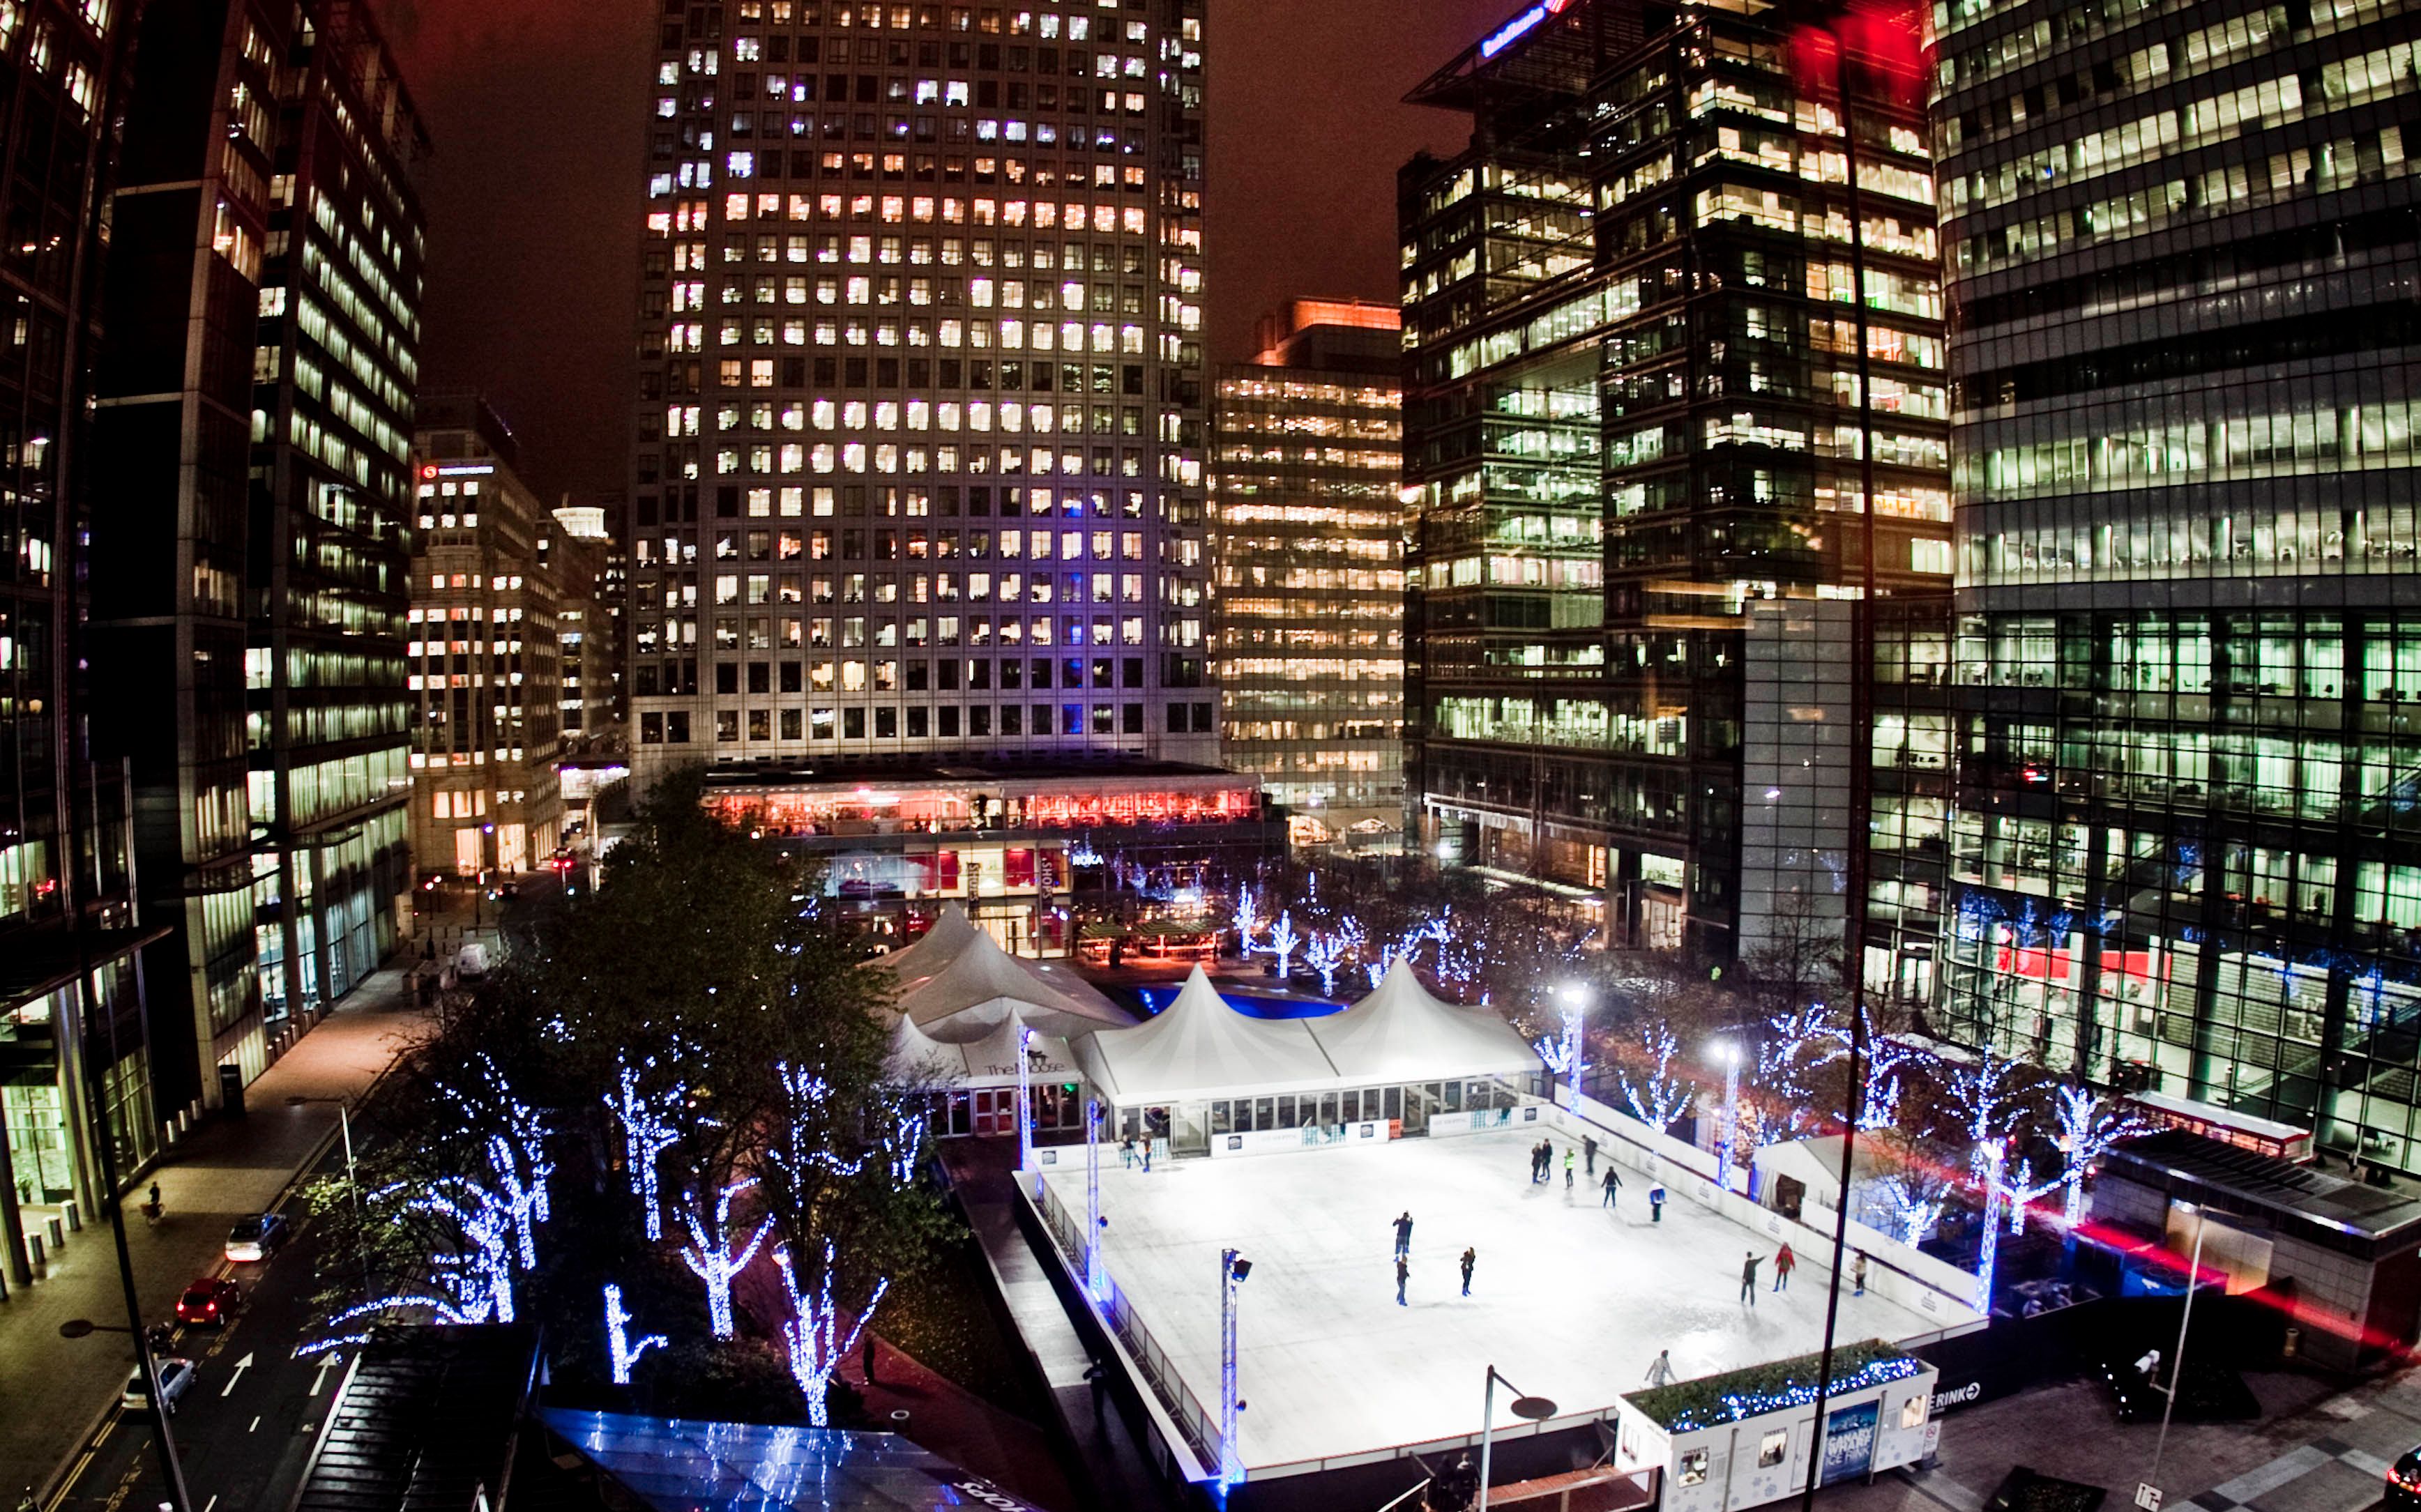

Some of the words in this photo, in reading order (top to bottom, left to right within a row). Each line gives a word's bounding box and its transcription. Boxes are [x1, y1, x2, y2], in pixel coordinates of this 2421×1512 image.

[1072, 855, 1105, 866] ROKA
[1042, 861, 1053, 899] SHOPS
[985, 1064, 1014, 1076] The
[1764, 1427, 1787, 1436] TICKETS
[1828, 1428, 1874, 1444] CANARY
[1684, 1446, 1708, 1455] TICKETS
[1828, 1436, 1872, 1456] WHARF
